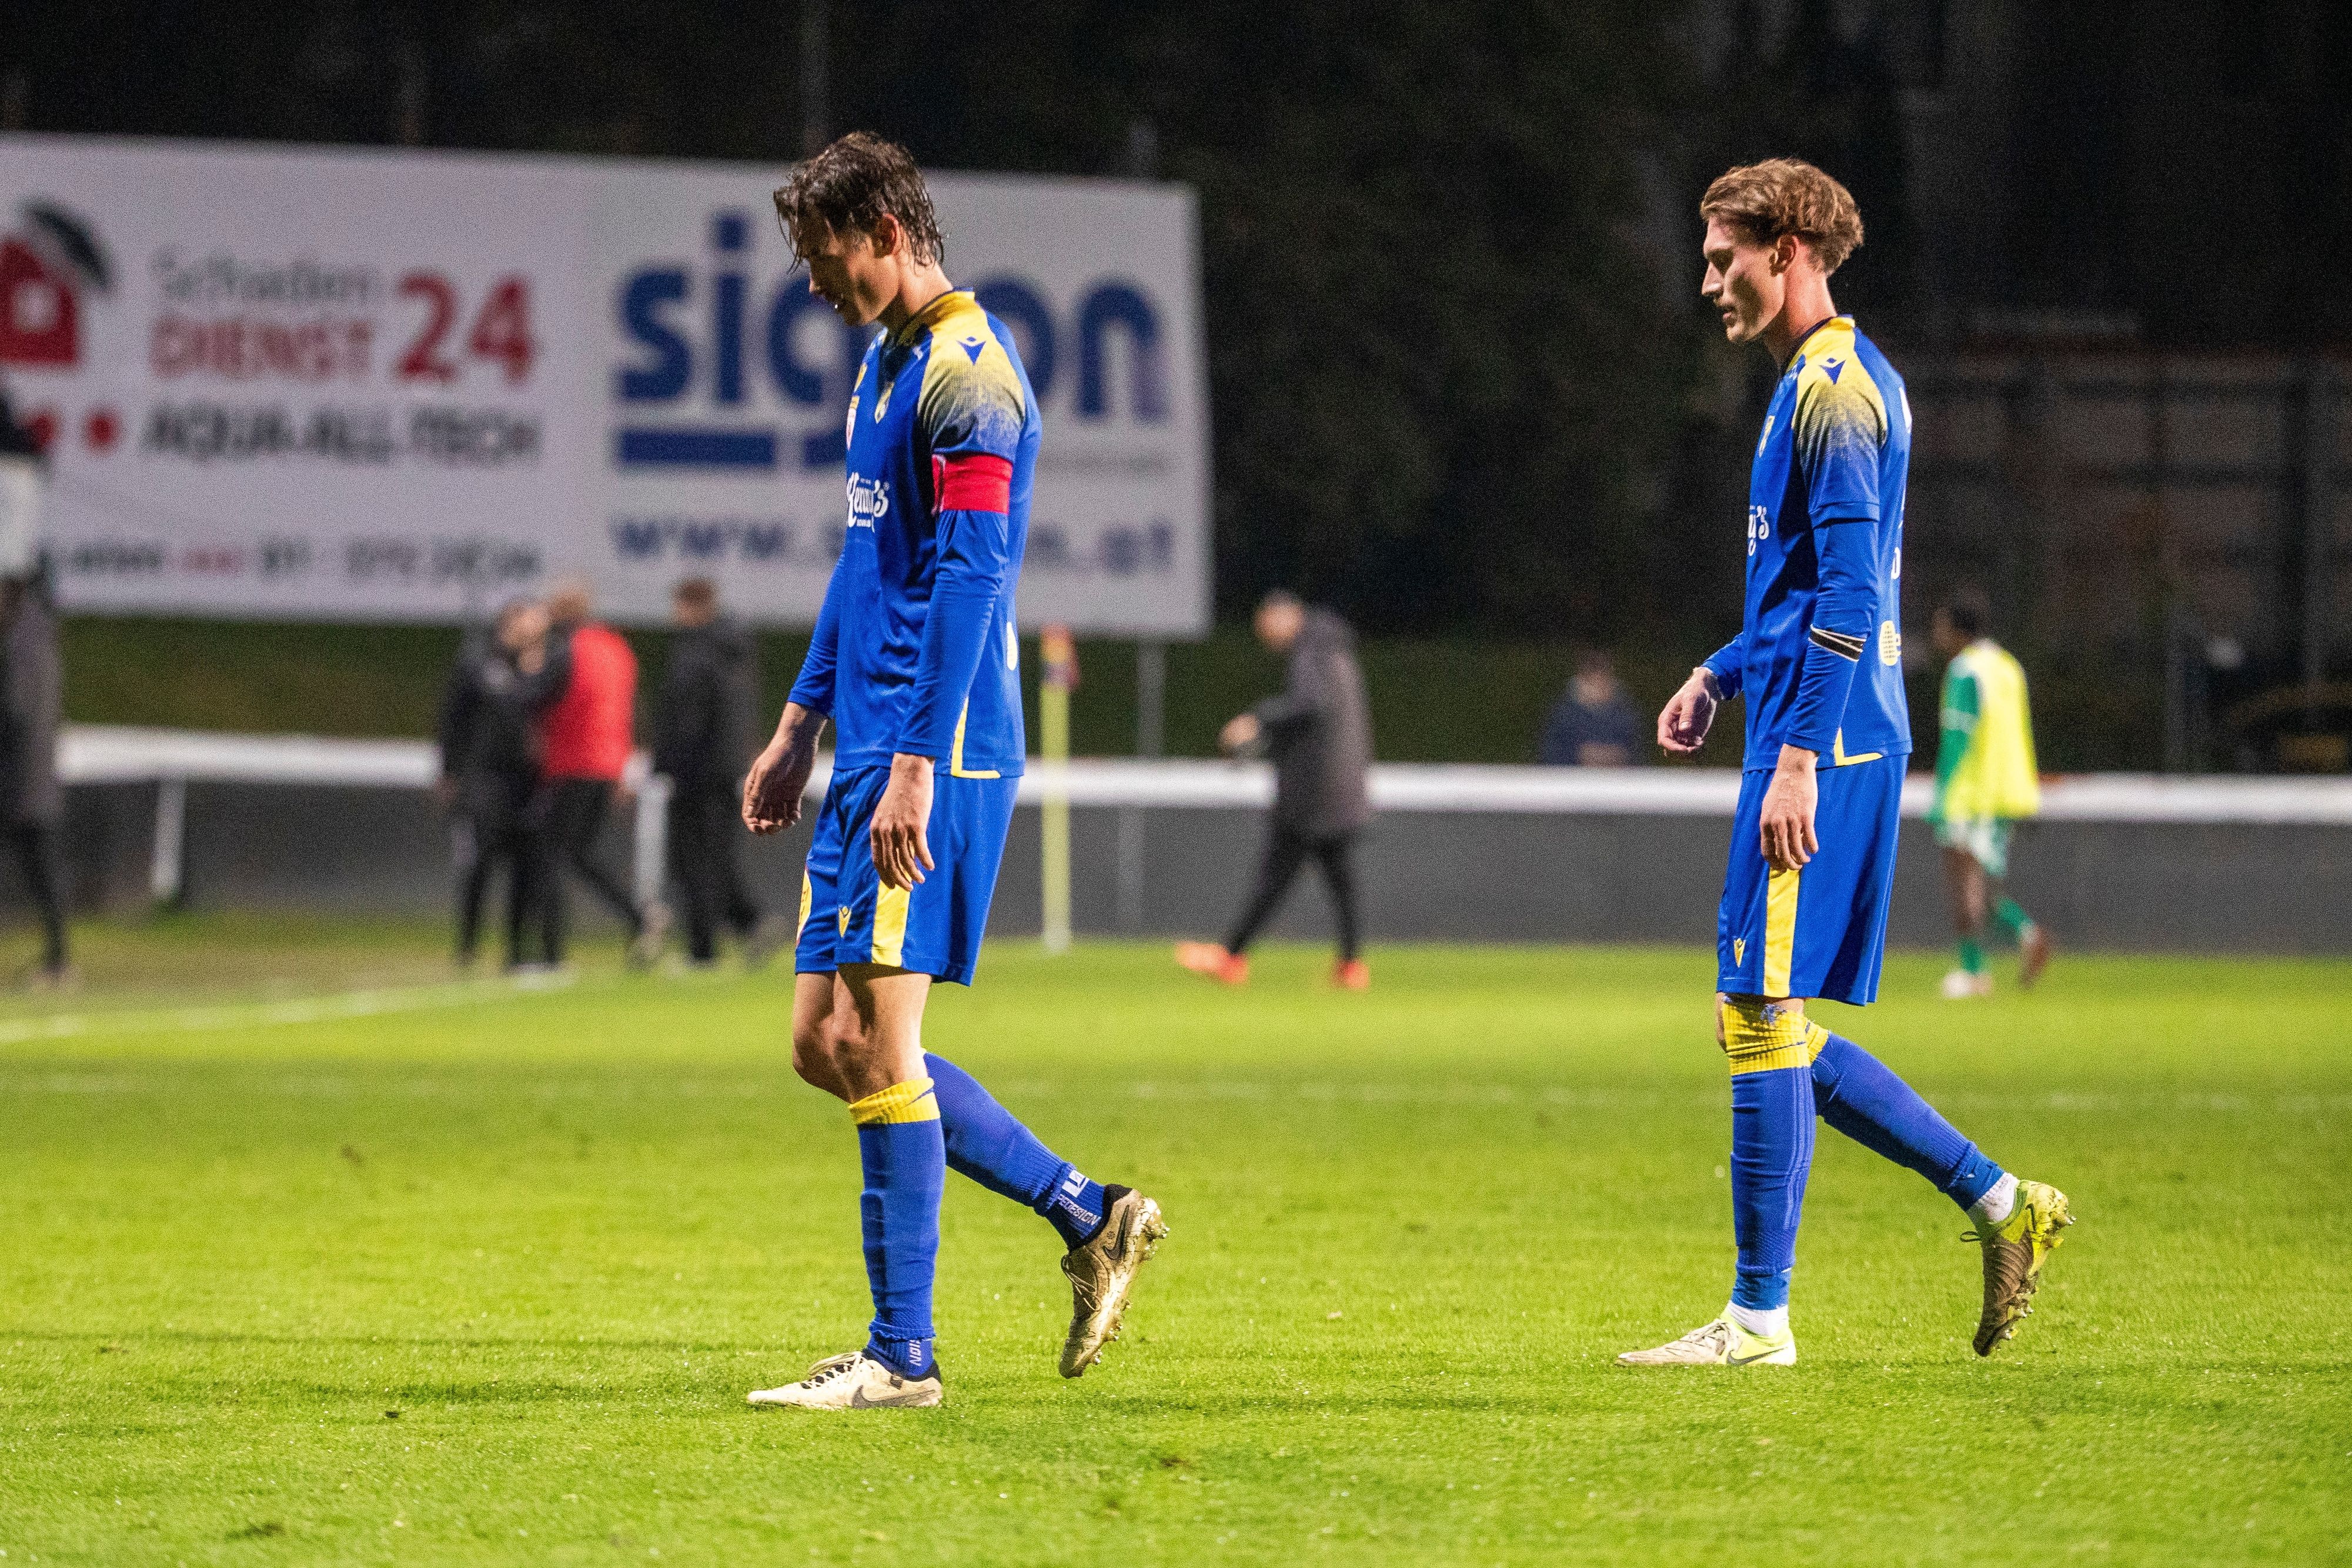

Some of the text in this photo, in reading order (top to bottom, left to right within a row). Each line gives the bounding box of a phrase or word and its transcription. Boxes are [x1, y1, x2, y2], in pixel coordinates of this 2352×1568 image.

[151, 316, 374, 380] DIENST
[395, 268, 534, 383] 24
[619, 214, 1165, 463] sigon
